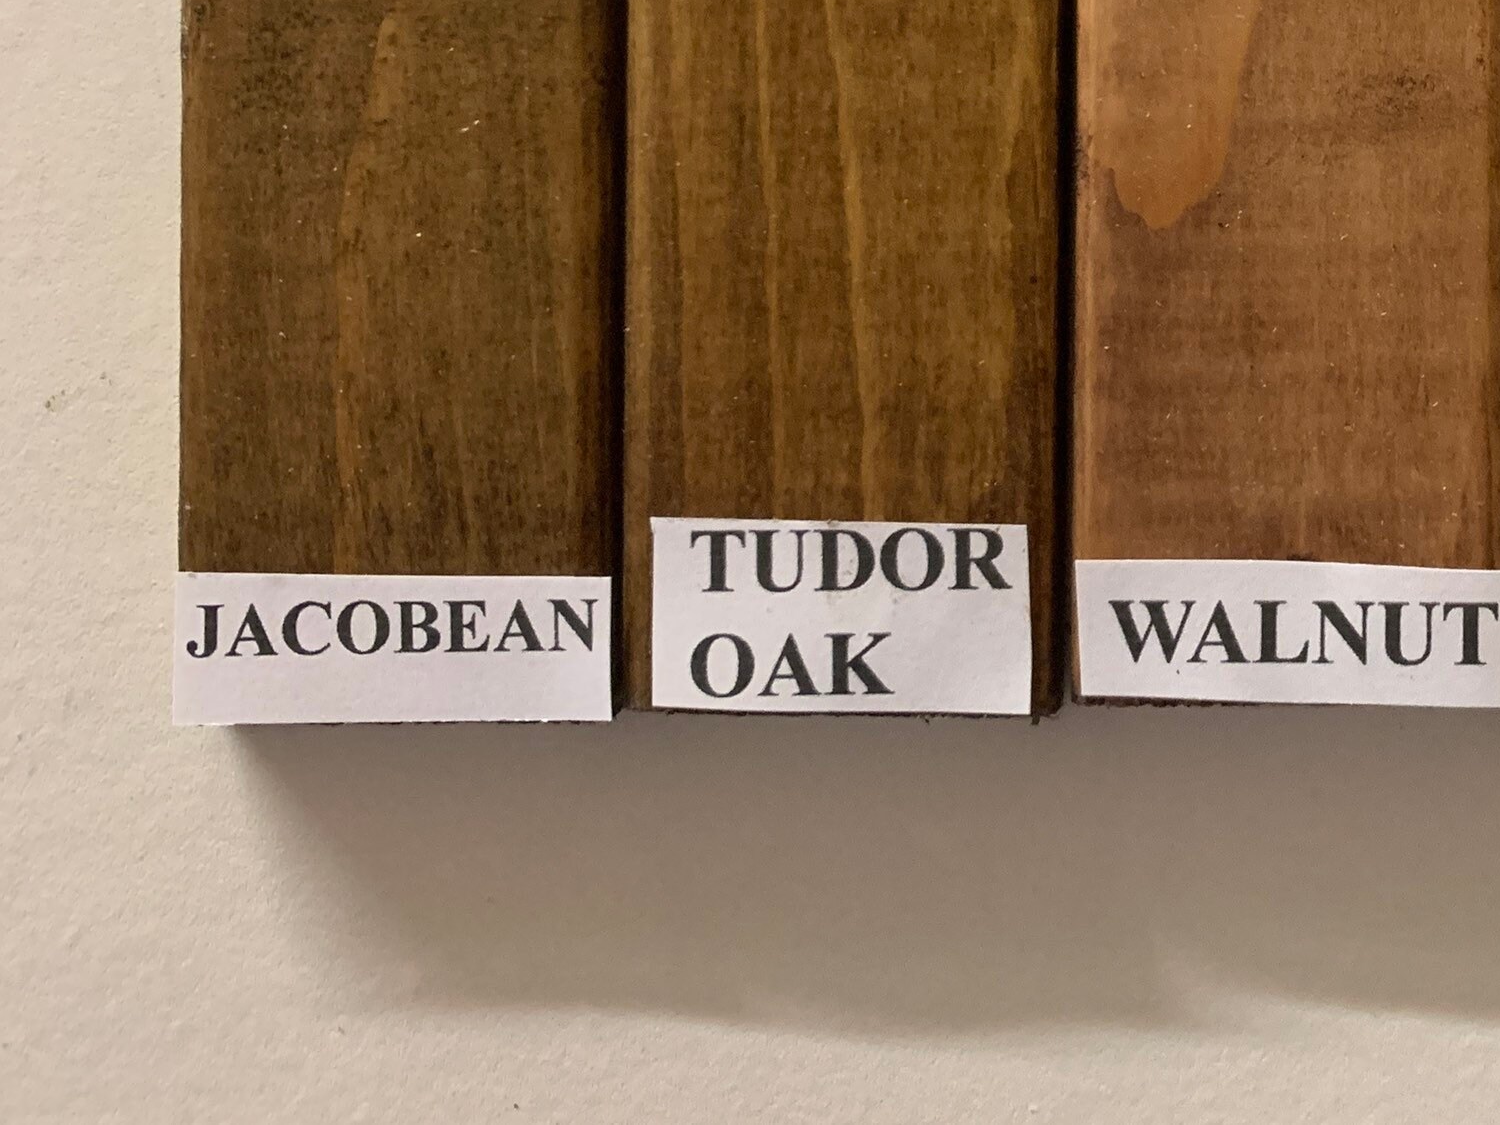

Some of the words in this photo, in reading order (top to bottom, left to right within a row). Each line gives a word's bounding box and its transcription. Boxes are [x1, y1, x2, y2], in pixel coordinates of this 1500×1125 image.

[690, 527, 1013, 593] TUDOR
[186, 599, 598, 659] JACOBEAN
[1108, 600, 1499, 667] WALNUT
[690, 633, 895, 698] OAK
